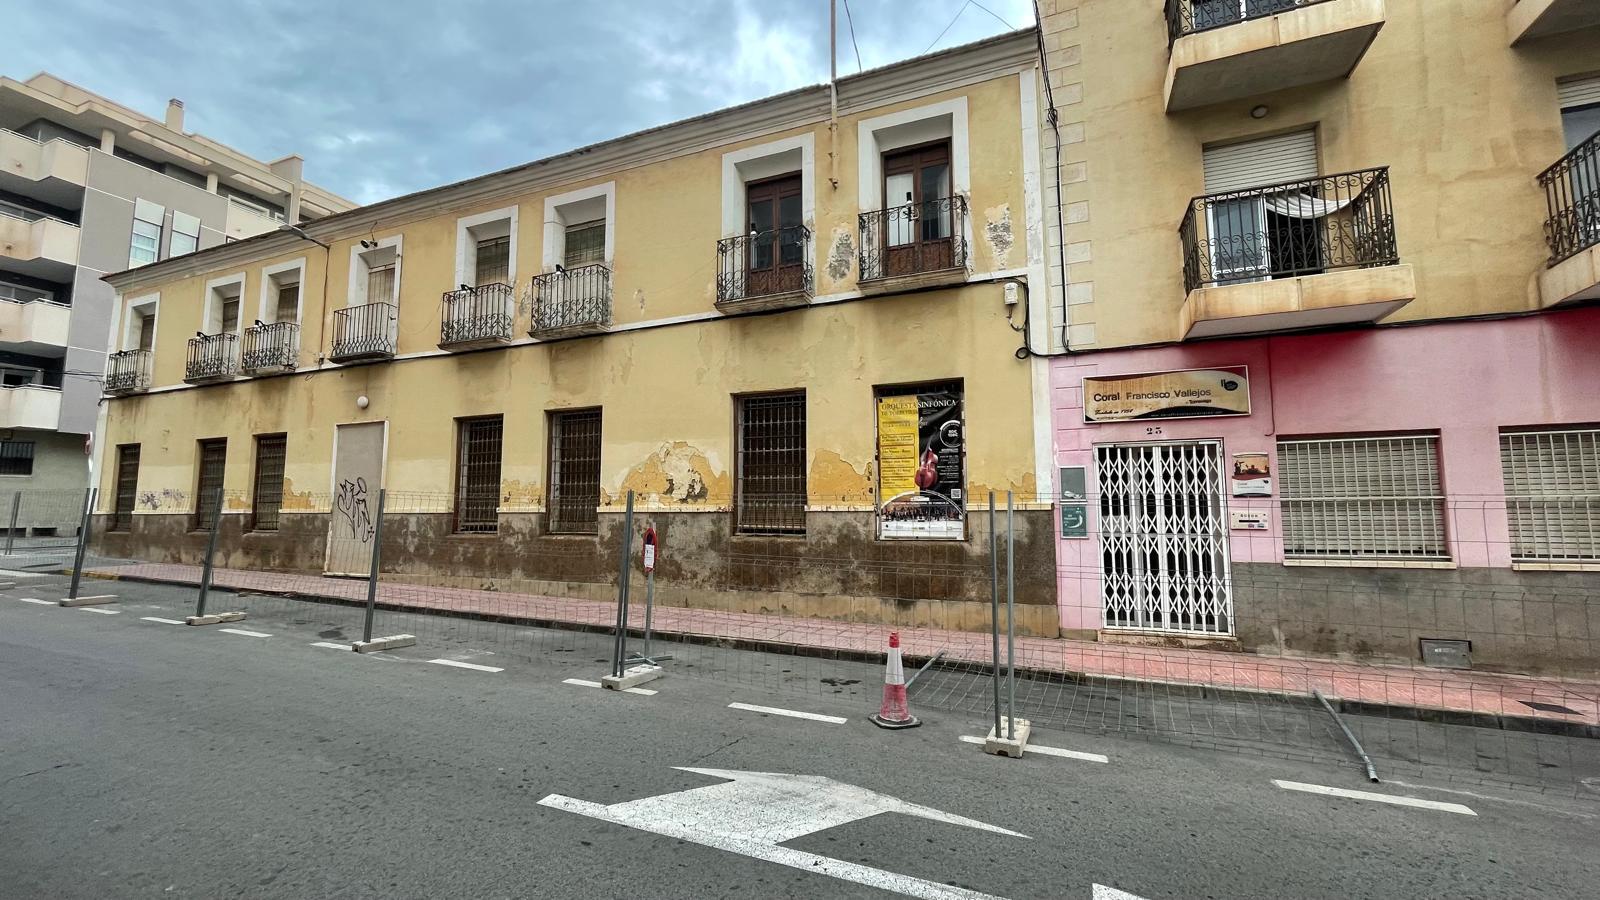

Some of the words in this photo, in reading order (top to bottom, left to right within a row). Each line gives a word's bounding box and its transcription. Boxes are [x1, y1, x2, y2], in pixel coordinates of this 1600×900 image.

[1093, 392, 1120, 402] Coral
[1126, 389, 1171, 400] Francisco
[1173, 388, 1212, 400] Vallejos
[881, 402, 917, 411] ORQUESTA
[917, 399, 957, 409] SINFÓNICA
[1146, 427, 1162, 435] 25
